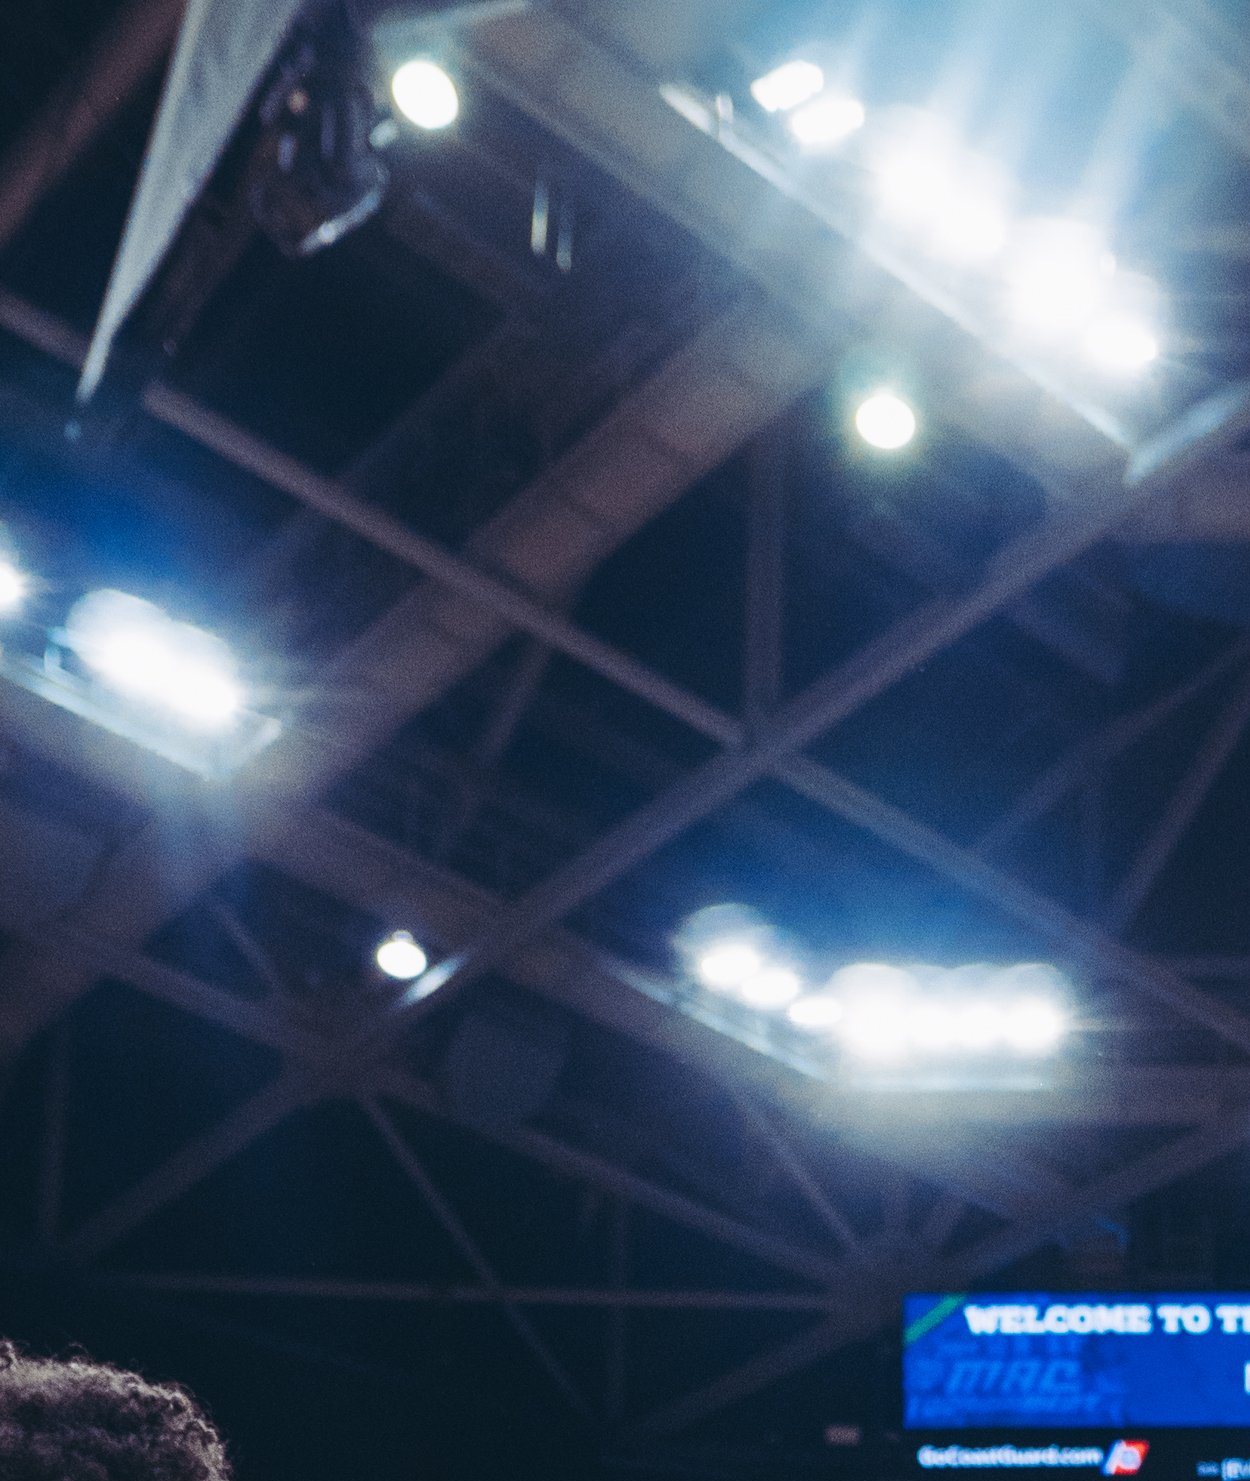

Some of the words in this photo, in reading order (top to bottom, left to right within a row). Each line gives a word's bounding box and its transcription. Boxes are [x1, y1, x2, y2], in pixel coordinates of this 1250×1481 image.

[964, 1305, 1151, 1335] WELCOME
[1157, 1305, 1210, 1334] TO
[917, 1444, 1103, 1468] GoCoastGuard.com
